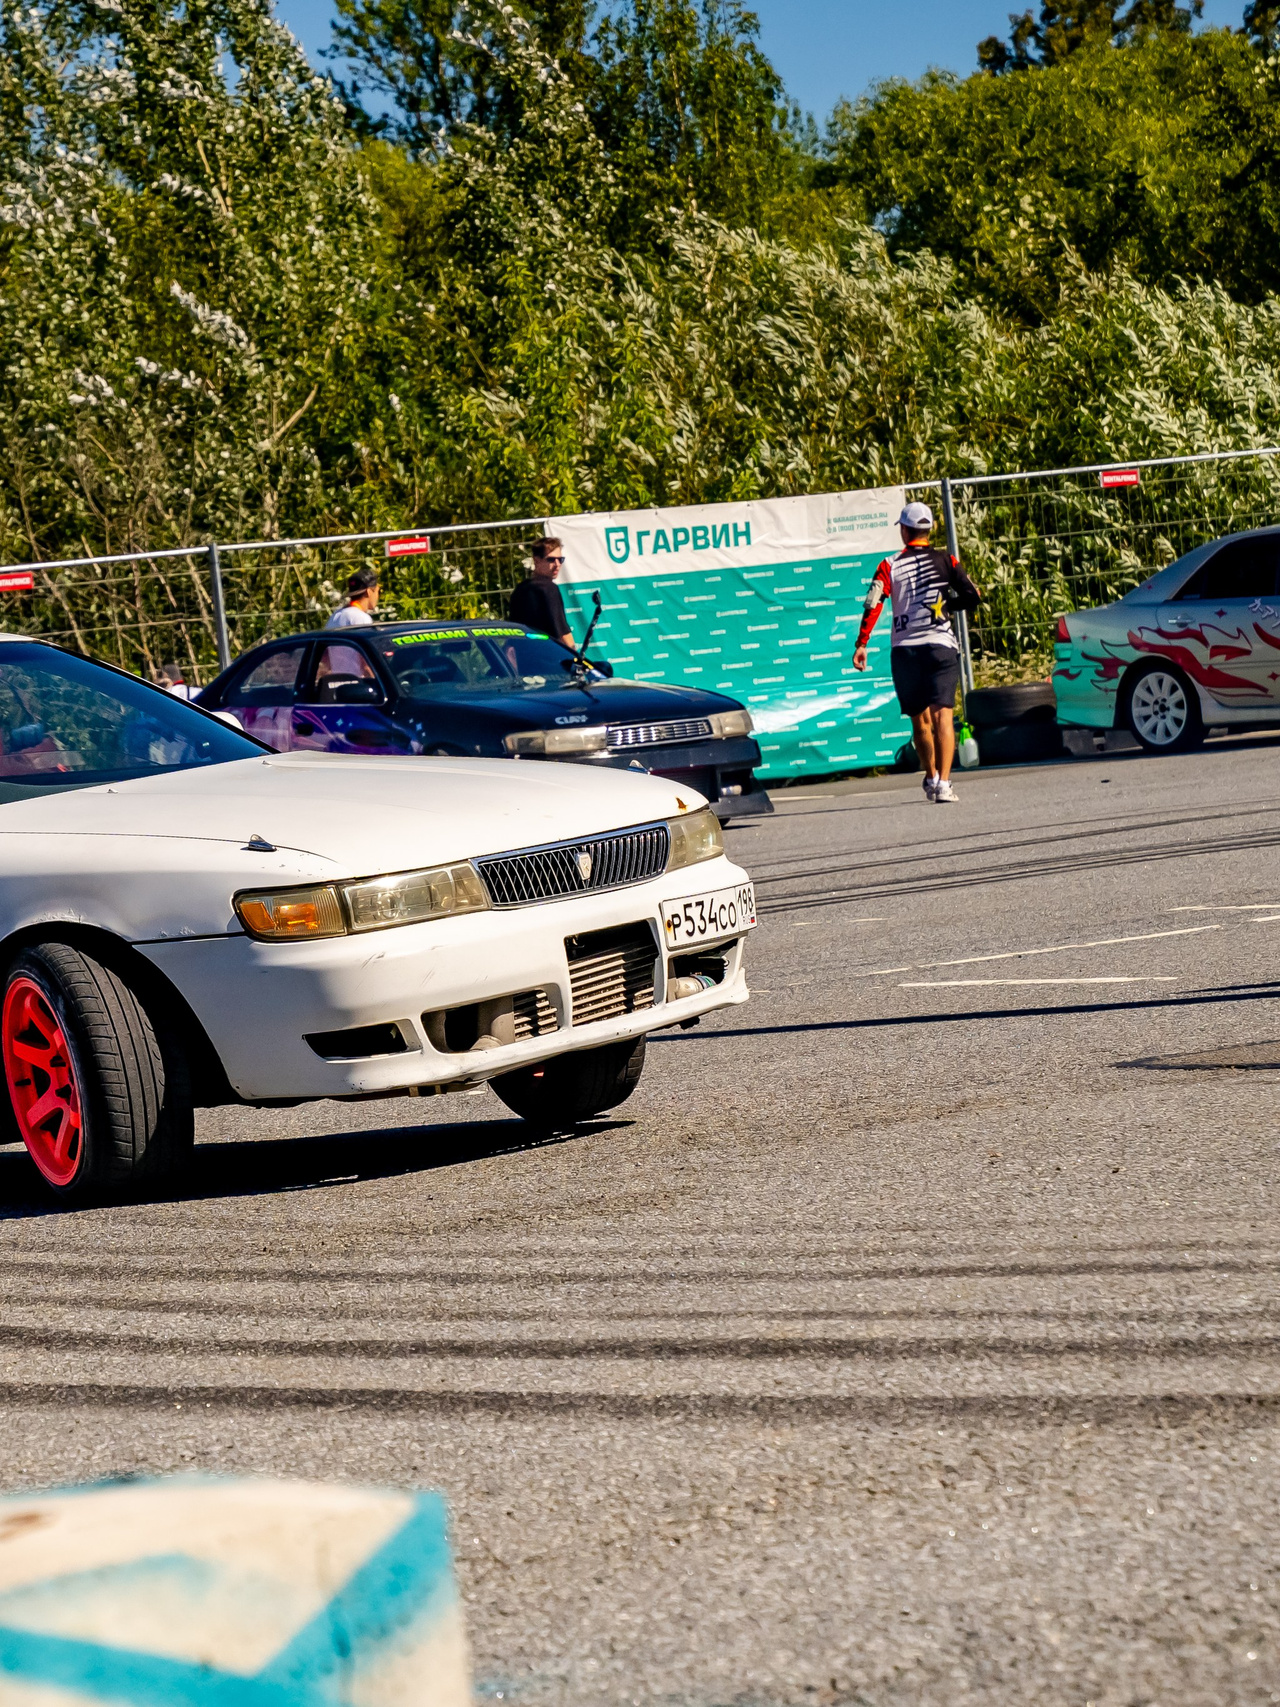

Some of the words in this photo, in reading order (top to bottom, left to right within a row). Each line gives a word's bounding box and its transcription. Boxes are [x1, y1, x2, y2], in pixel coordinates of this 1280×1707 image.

[636, 521, 751, 556] ГАРВИН
[392, 629, 469, 646] TSUNAMI
[471, 628, 525, 637] PICNIC
